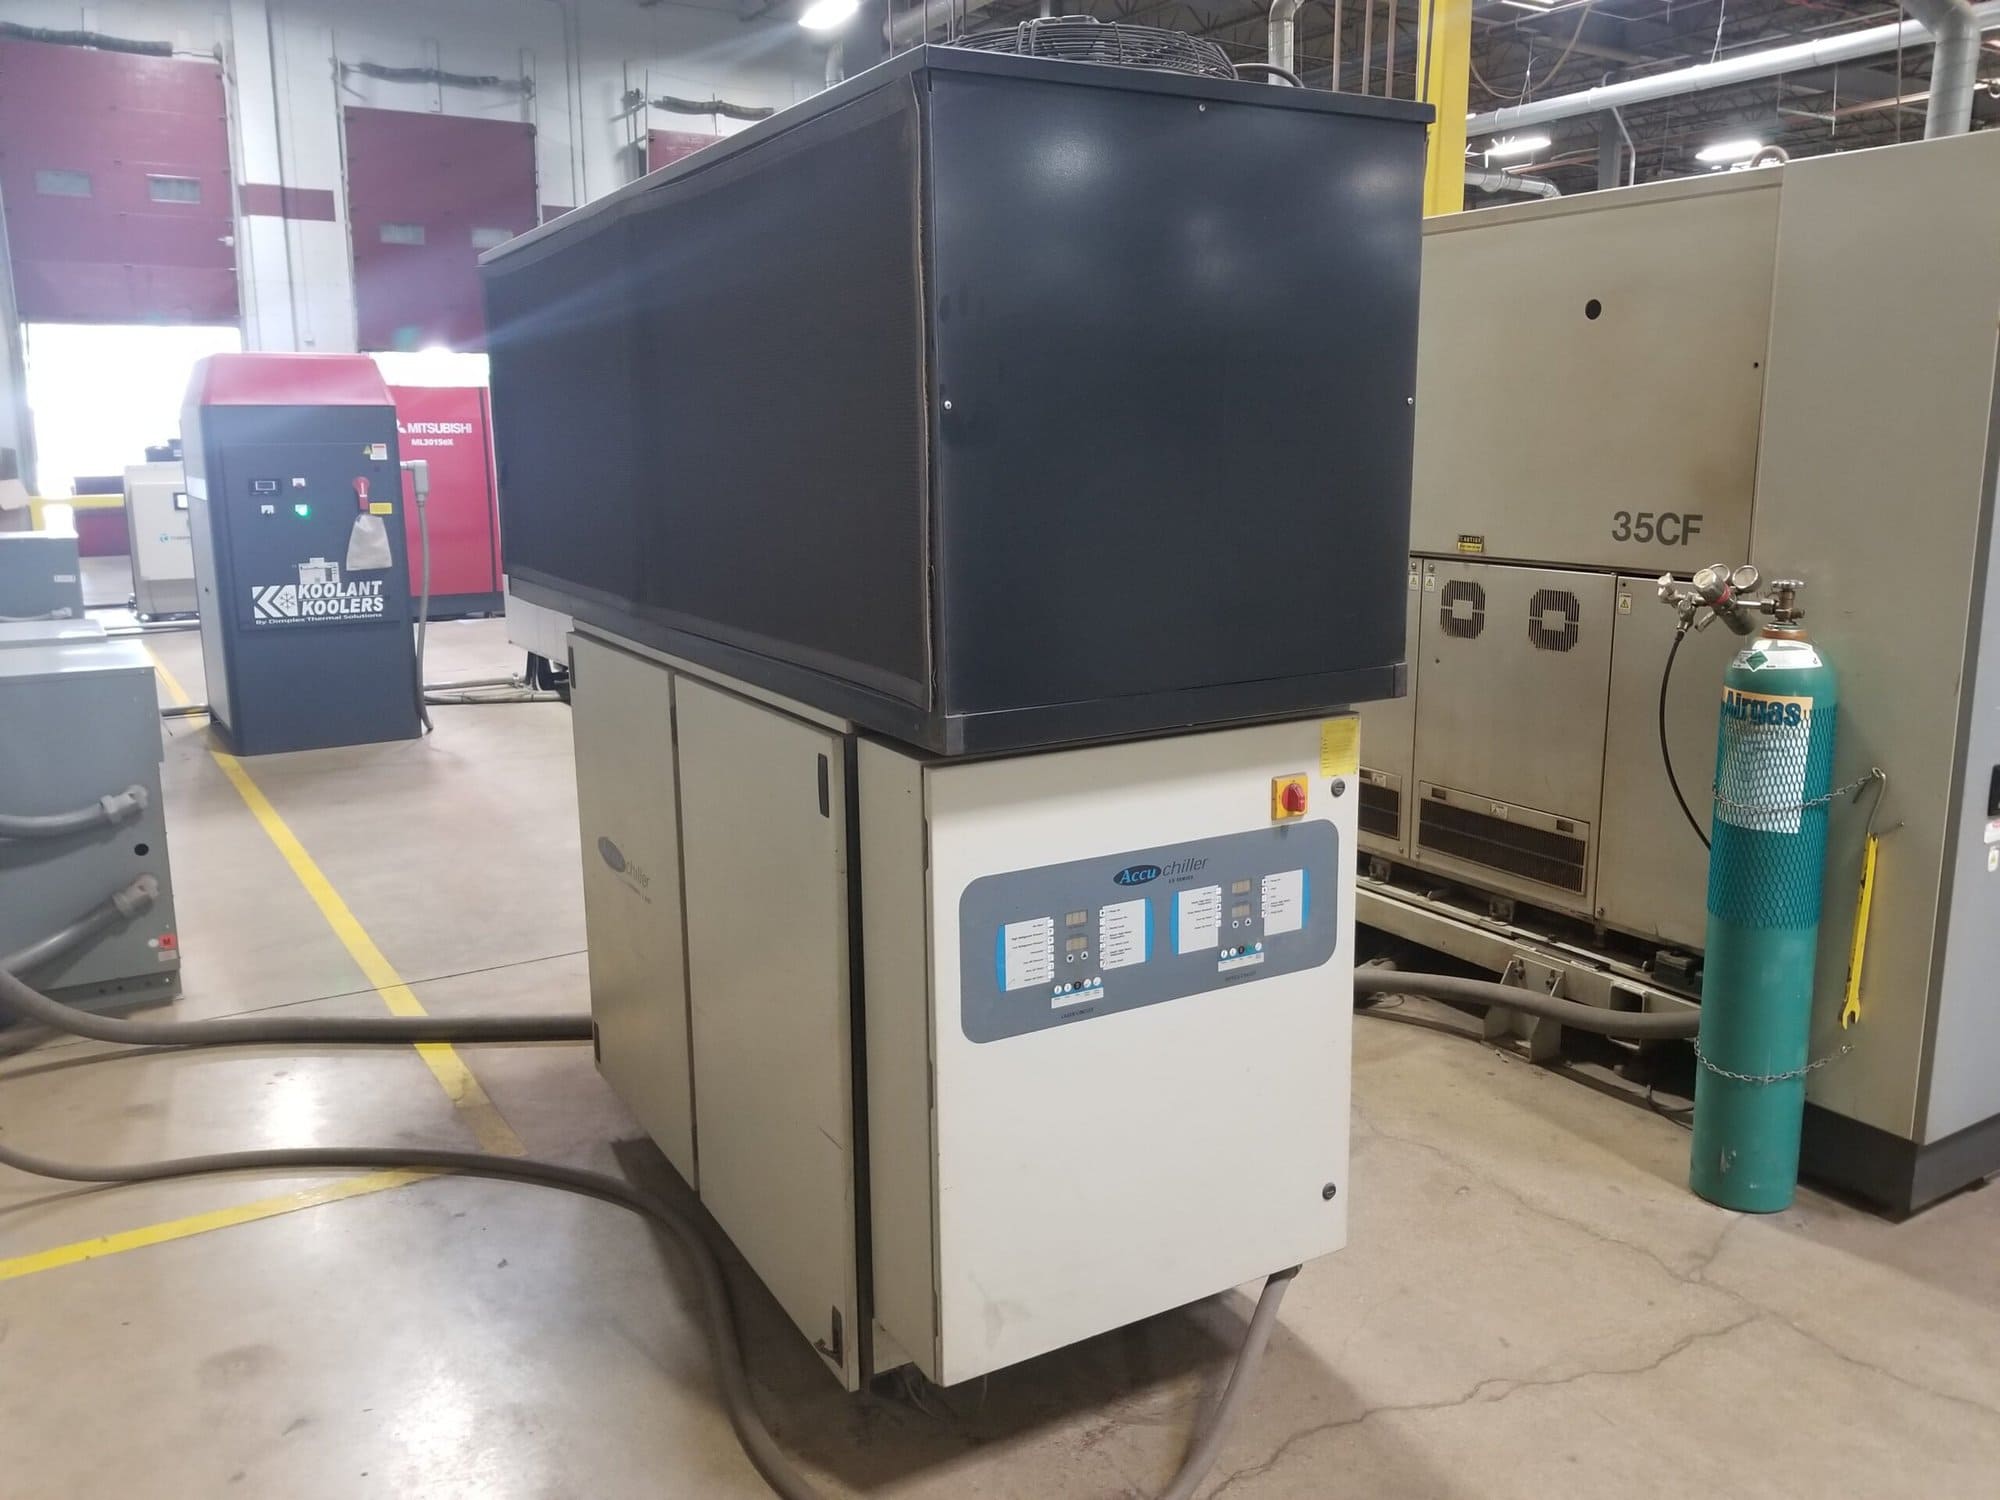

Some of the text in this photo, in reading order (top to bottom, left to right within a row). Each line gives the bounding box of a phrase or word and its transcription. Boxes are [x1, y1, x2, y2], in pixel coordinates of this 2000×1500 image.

[407, 422, 473, 434] MITSUBISHI
[1612, 511, 1704, 546] 35CF
[298, 580, 383, 599] KOOLANT
[301, 597, 384, 616] KOOLERS
[307, 615, 341, 623] Thermal
[343, 613, 382, 621] Solutions
[1724, 690, 1801, 727] Airgas
